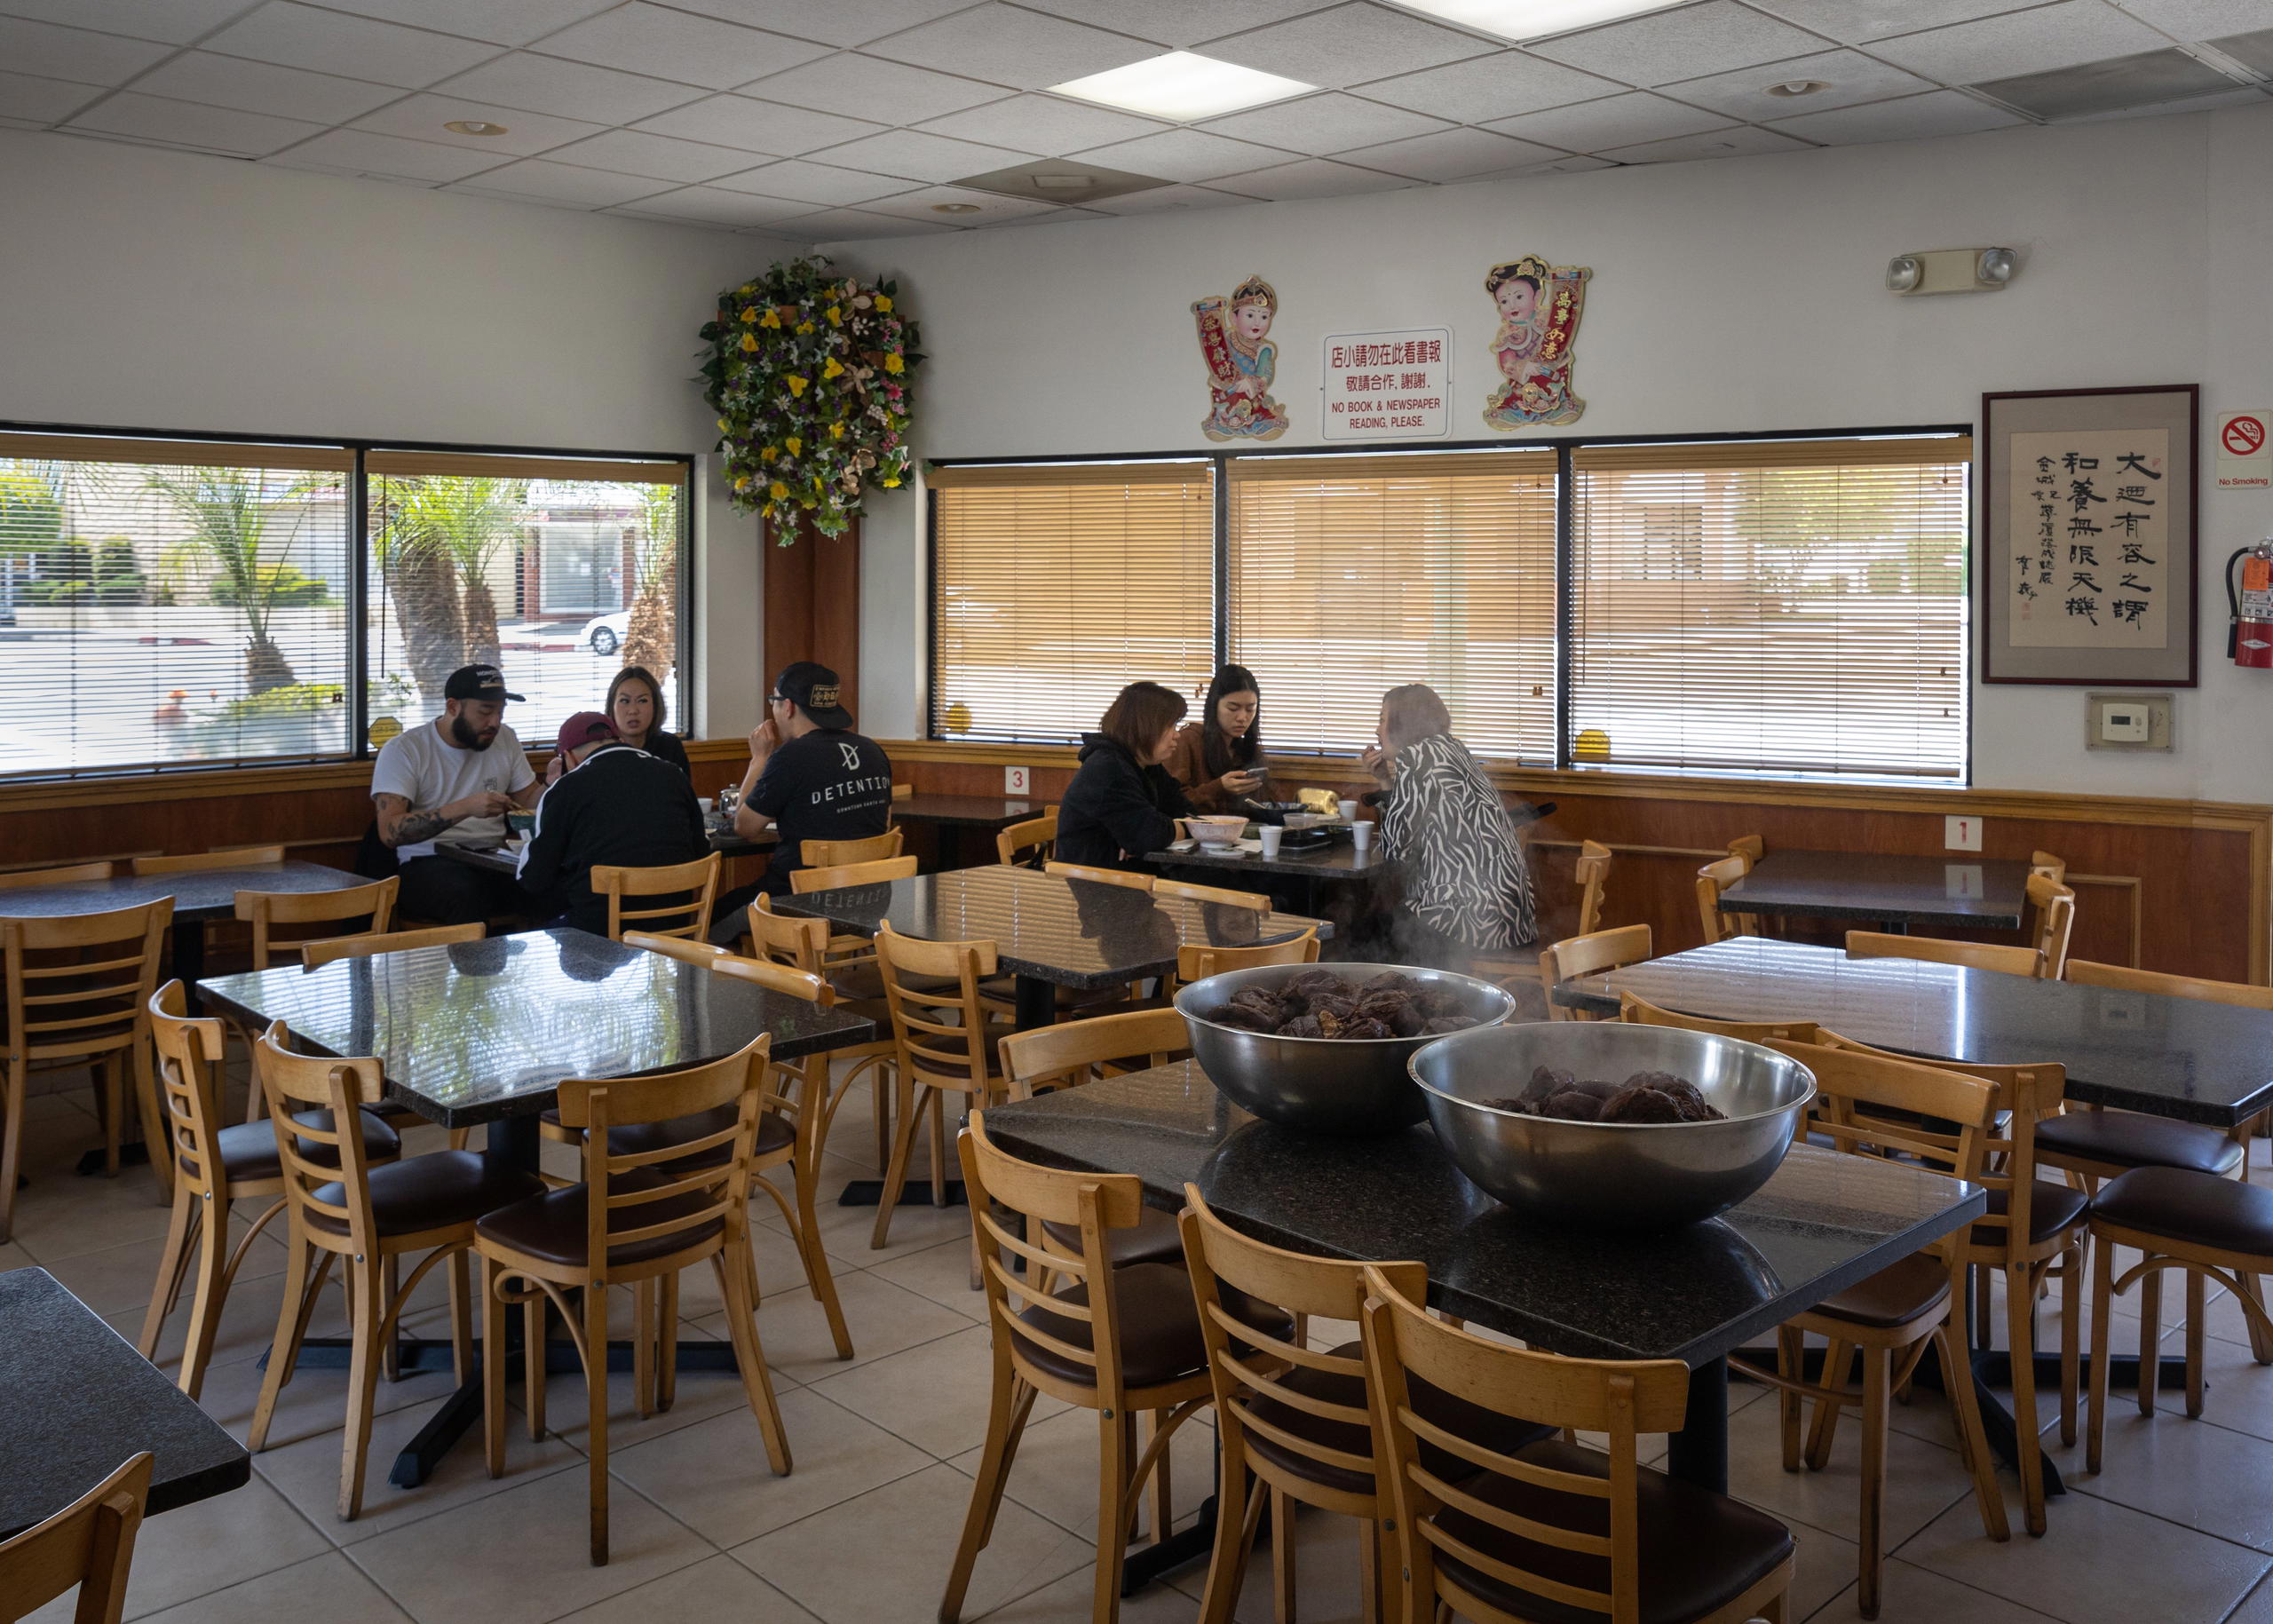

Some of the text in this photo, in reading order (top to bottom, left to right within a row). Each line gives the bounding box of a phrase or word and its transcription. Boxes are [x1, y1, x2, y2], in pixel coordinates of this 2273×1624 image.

[1541, 291, 1572, 360] 萬事如意
[1332, 340, 1441, 368] 店小請勿在此看書報
[1332, 398, 1441, 413] NO BOOK & NEWSPAPER
[1350, 416, 1425, 430] READING, PLEASE.
[2232, 478, 2269, 487] Smoking
[1013, 770, 1023, 788] 3
[1959, 821, 1968, 844] 1
